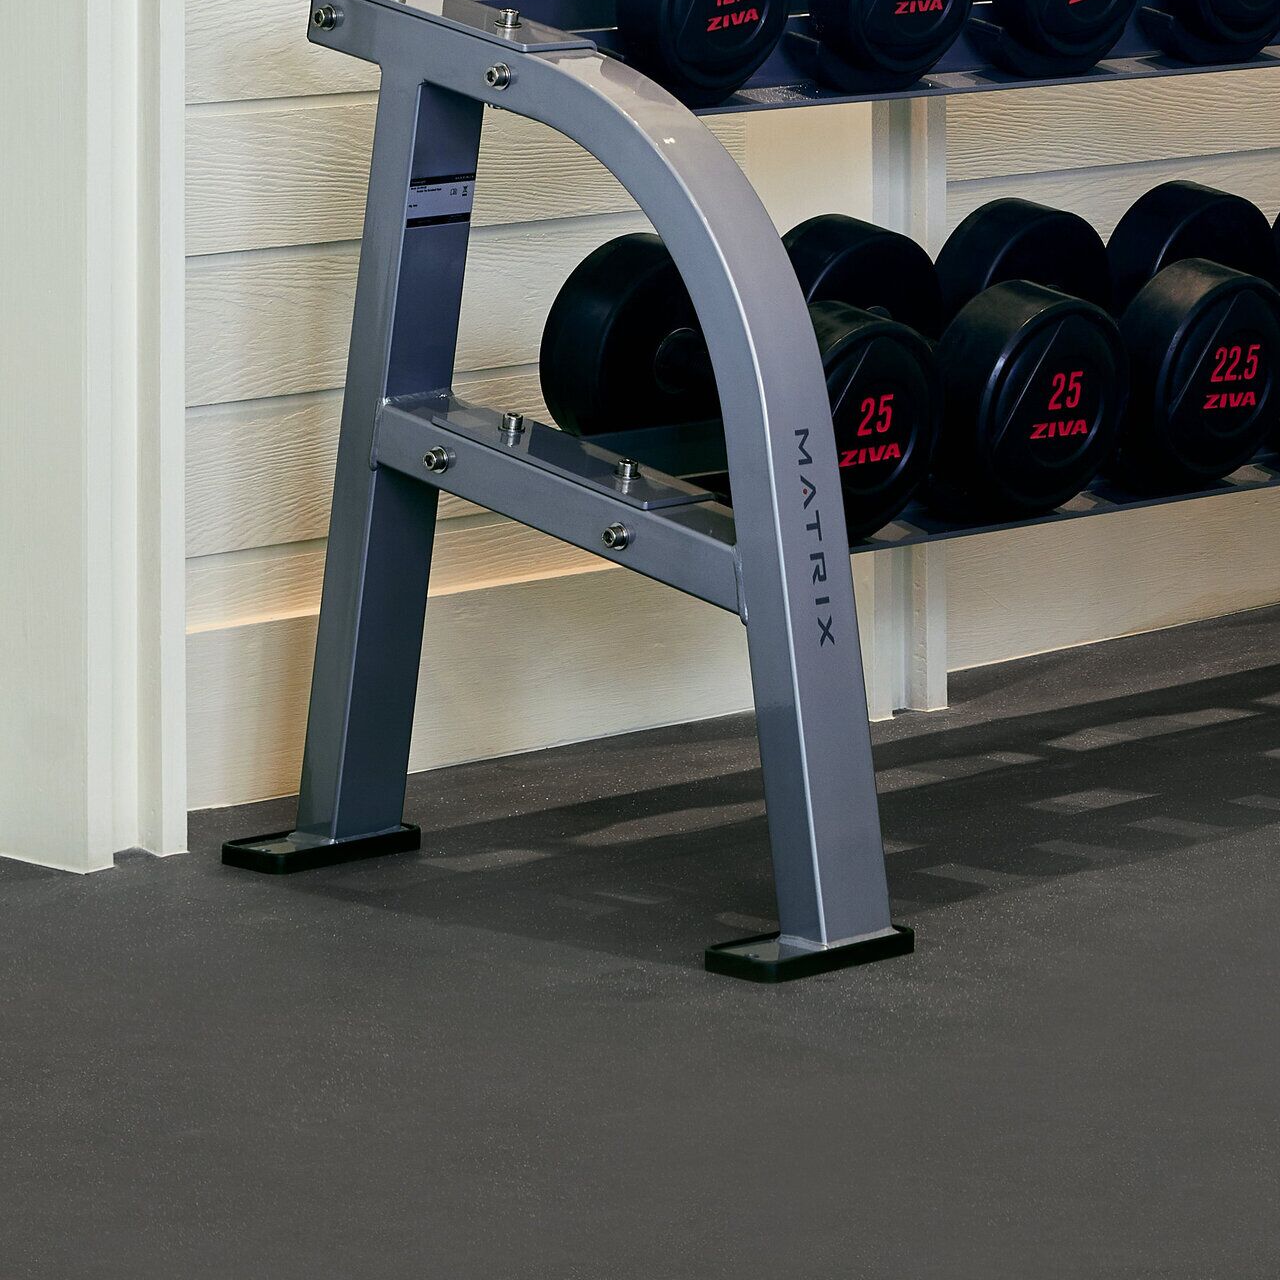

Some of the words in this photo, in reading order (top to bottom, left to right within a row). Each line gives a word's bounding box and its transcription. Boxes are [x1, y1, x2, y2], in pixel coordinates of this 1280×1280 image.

[706, 7, 760, 32] ZIVA
[1210, 344, 1261, 383] 22.5
[1047, 370, 1085, 411] 25
[1202, 390, 1257, 410] ZIVA
[854, 393, 895, 438] 25
[1029, 418, 1088, 440] ZIVA
[838, 441, 902, 468] ZIVA
[794, 427, 836, 647] MATRIX
